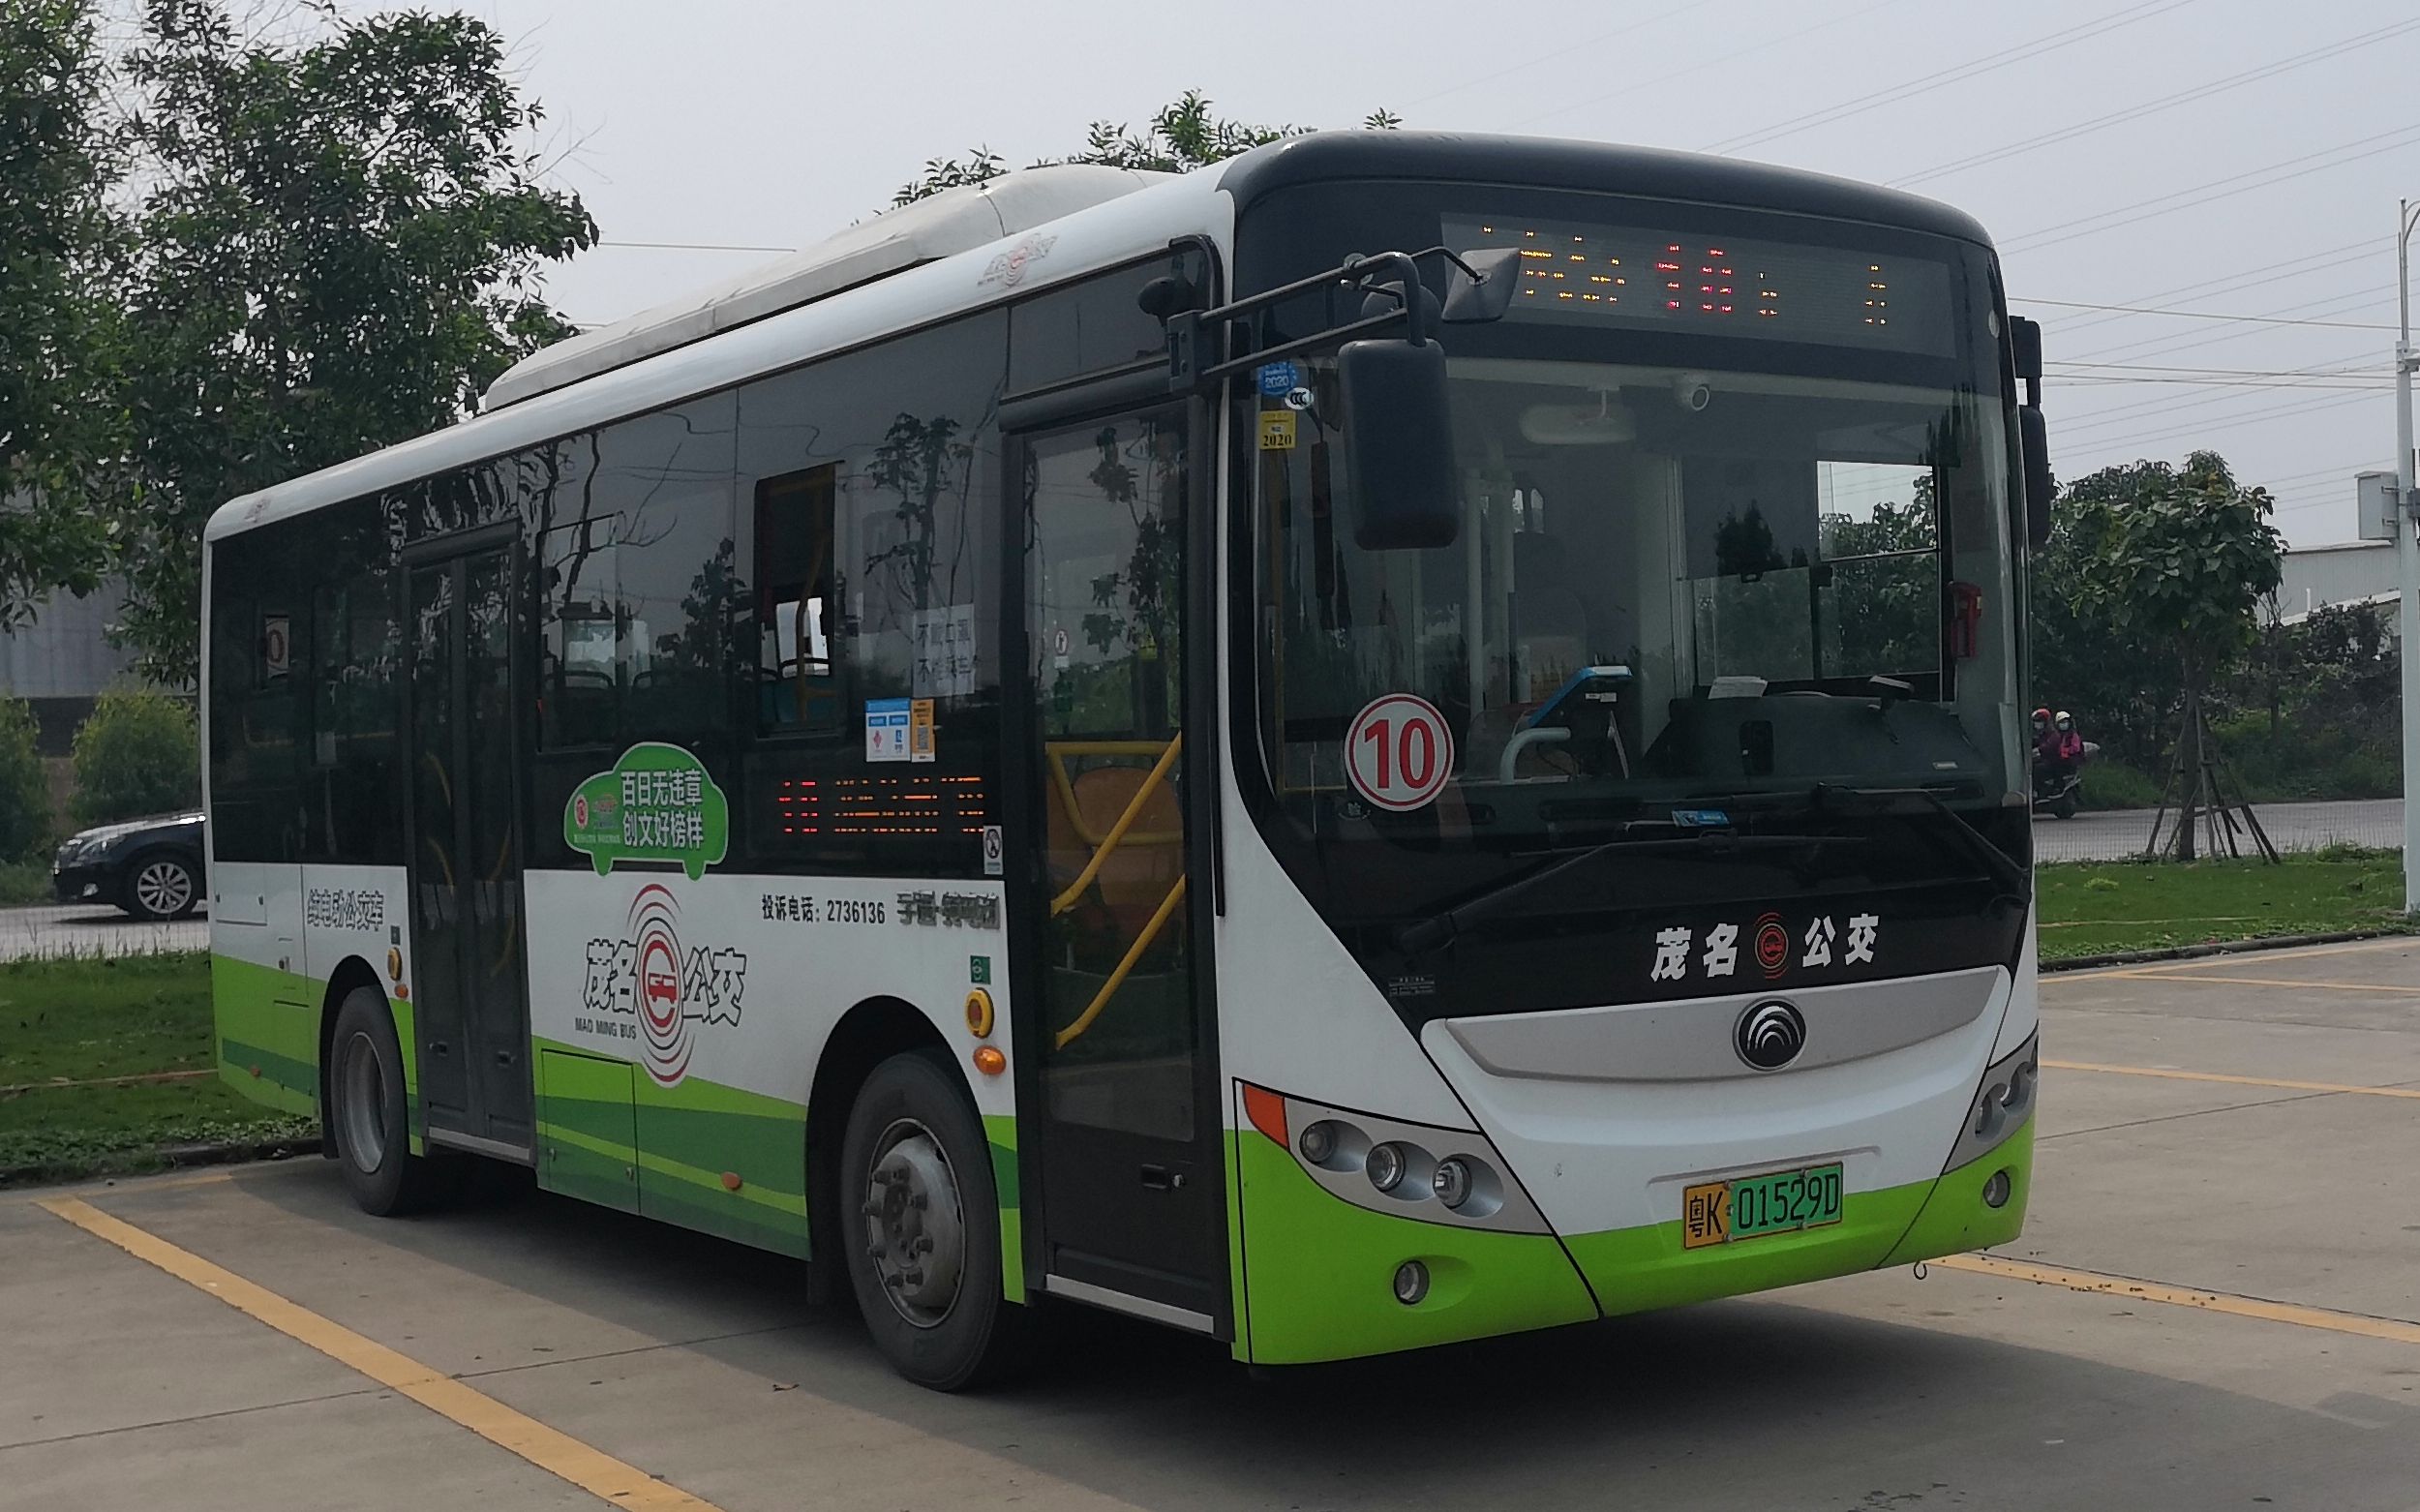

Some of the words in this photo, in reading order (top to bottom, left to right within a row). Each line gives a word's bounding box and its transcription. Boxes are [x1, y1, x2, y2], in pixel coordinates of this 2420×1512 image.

[1263, 434, 1291, 446] 2020
[1365, 718, 1435, 789] 10
[620, 769, 703, 806] 百日无违章
[622, 810, 705, 849] 创文好榜样
[307, 889, 384, 932] 纯电动公交车
[575, 1017, 593, 1033] MAO
[595, 1019, 618, 1037] MING
[620, 1023, 637, 1039] BUS
